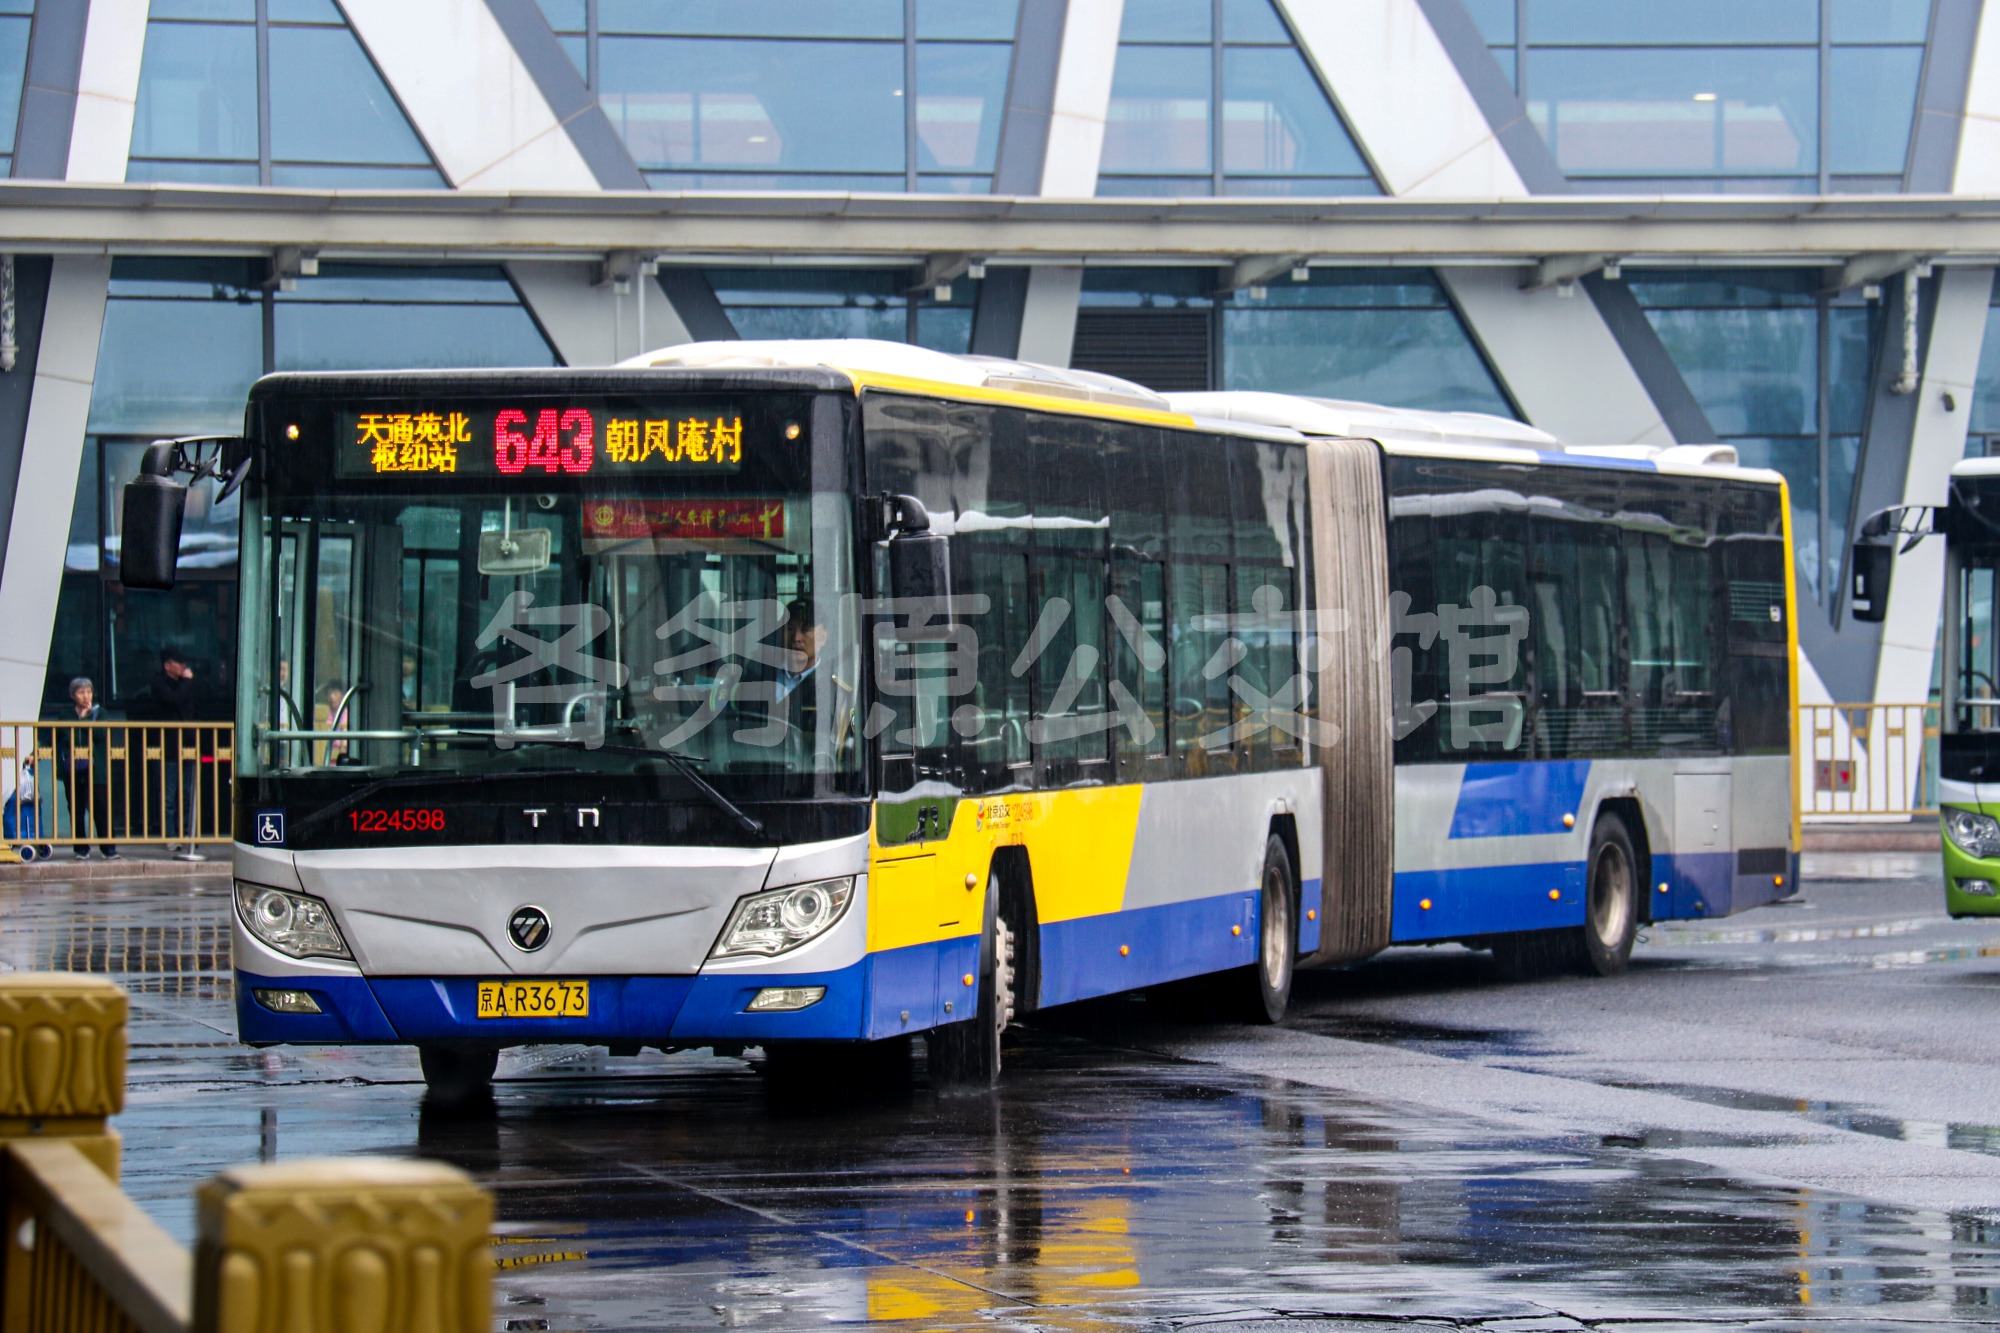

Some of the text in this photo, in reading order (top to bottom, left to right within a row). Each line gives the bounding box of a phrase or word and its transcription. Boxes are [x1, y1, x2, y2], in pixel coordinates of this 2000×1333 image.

[356, 412, 471, 444] 天通苑北
[495, 409, 594, 473] 643
[605, 417, 742, 463] 朝凤庵村
[371, 441, 457, 472] 枢纽站
[349, 809, 446, 832] 1224598
[986, 804, 1011, 820] 北京公交
